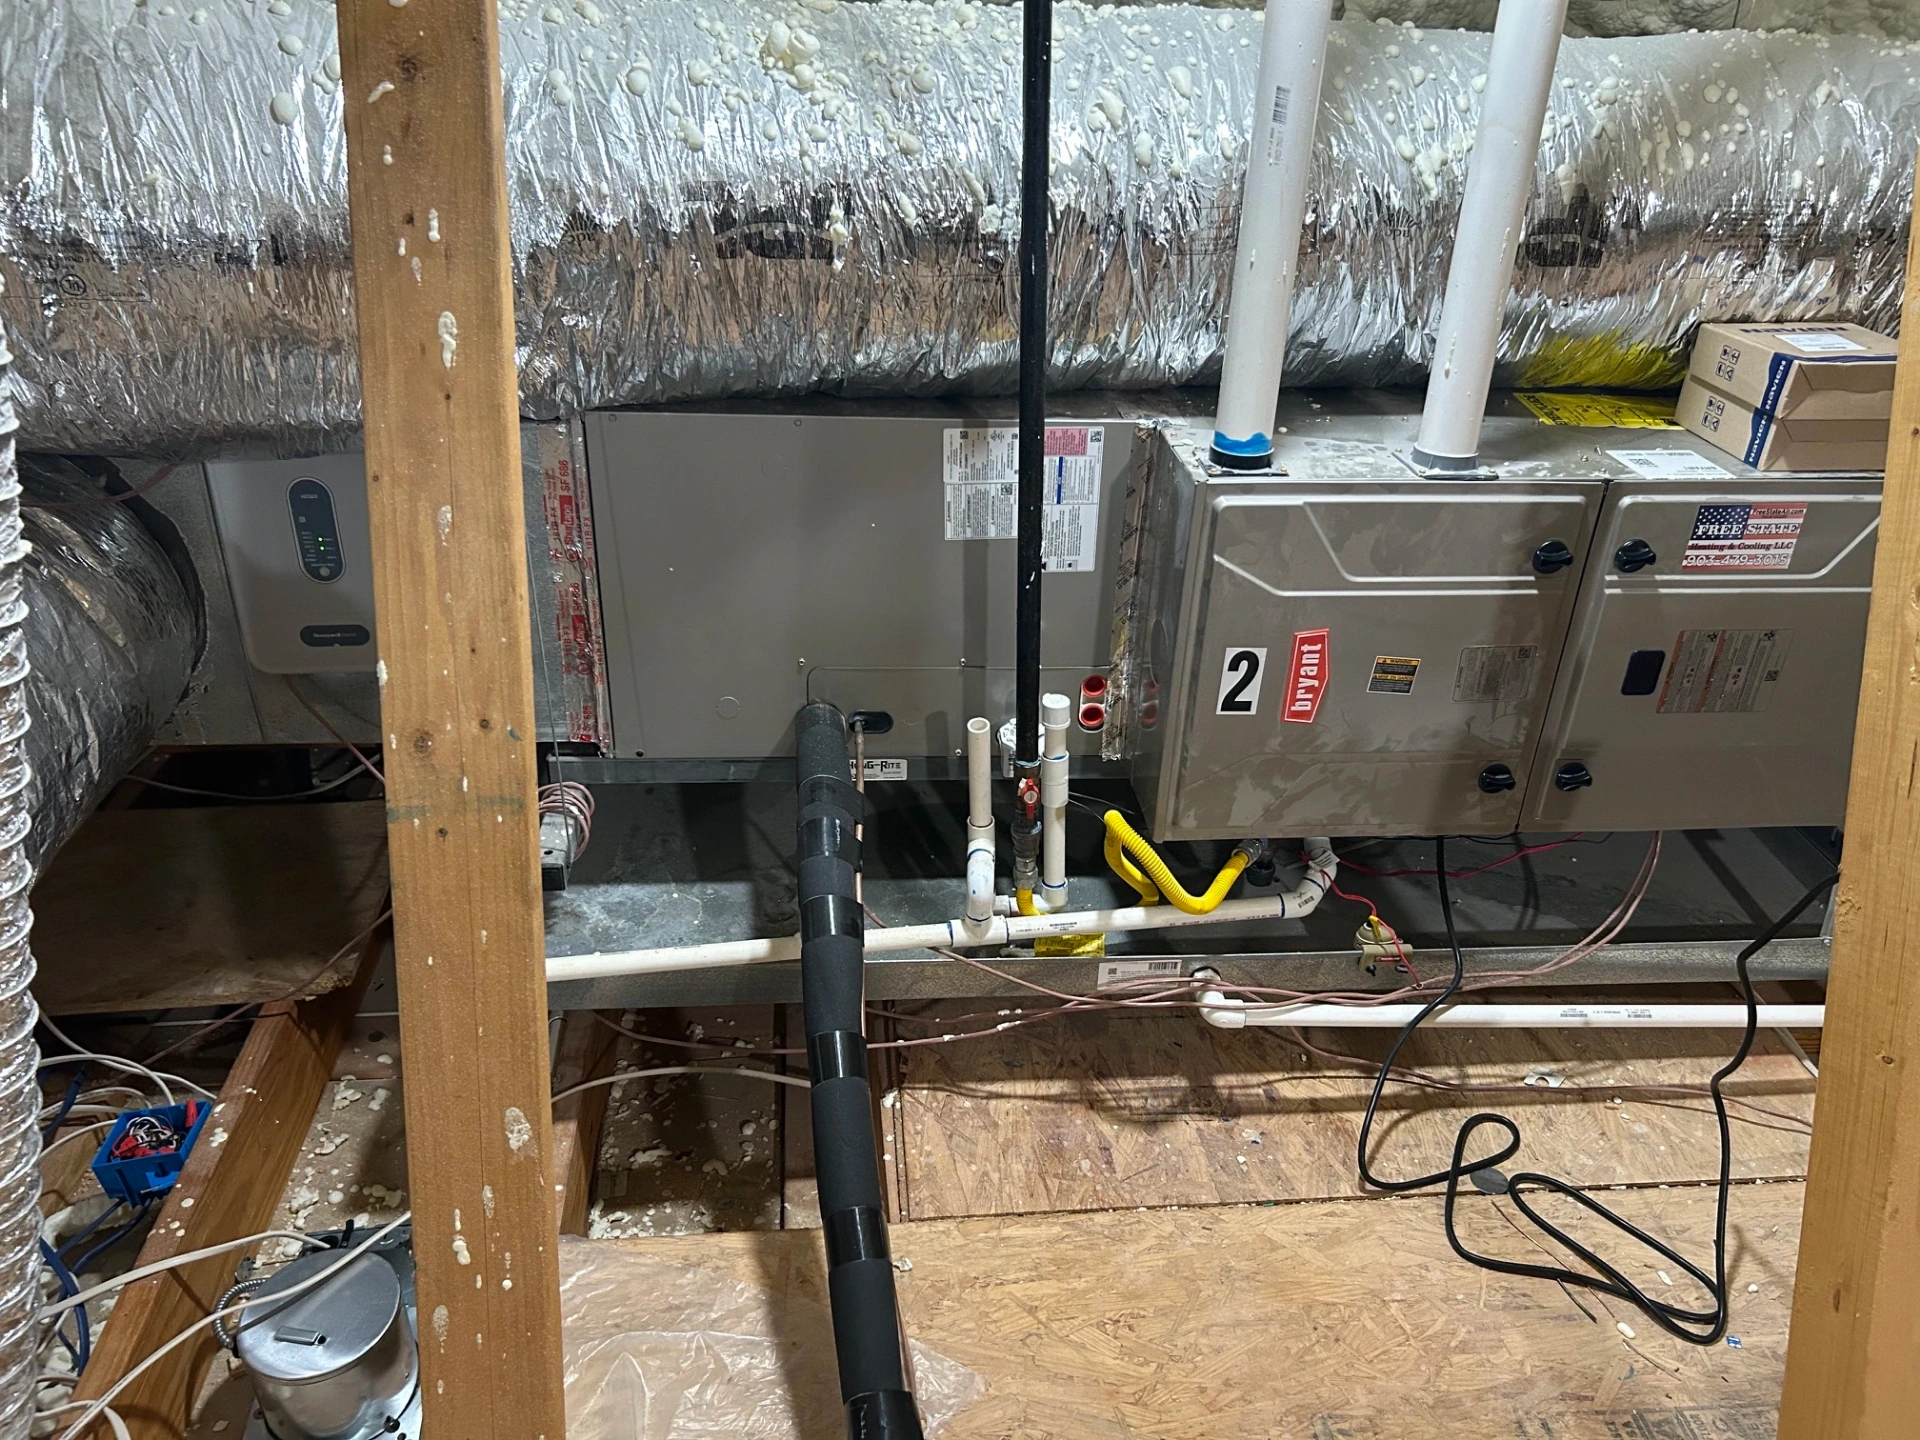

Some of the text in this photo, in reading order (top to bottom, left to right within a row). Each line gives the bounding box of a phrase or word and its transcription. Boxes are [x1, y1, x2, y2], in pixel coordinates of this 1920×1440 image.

[559, 459, 569, 477] 686
[1696, 523, 1800, 536] FREE STATE
[1690, 542, 1725, 552] Heating
[1738, 542, 1772, 552] Cooling
[1774, 542, 1794, 550] LLC
[1686, 553, 1789, 567] 903-479-3015
[1220, 650, 1260, 712] 2
[1291, 643, 1323, 713] bryant
